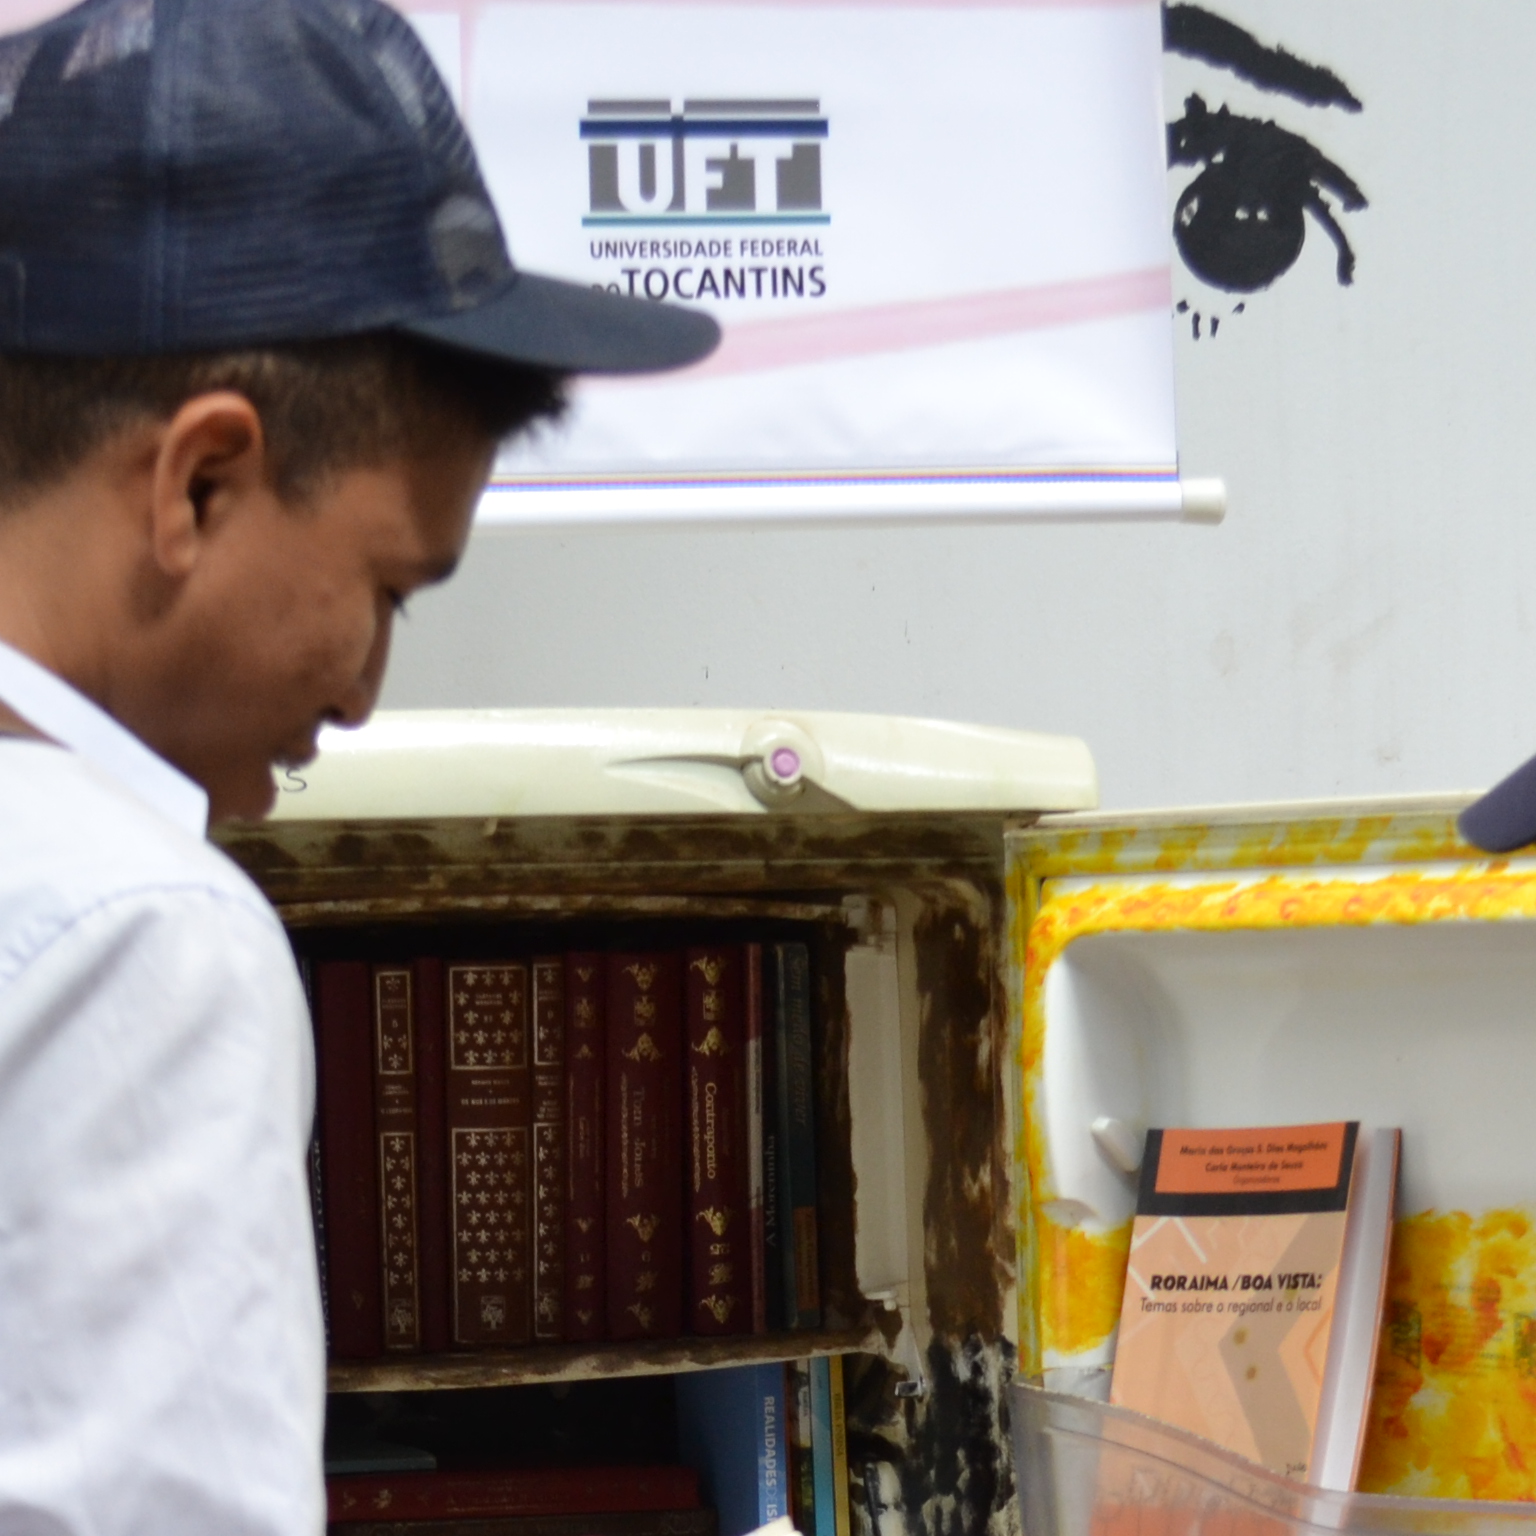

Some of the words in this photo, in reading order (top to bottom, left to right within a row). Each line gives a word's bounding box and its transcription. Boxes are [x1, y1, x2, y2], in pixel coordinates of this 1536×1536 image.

[590, 240, 732, 259] UNIVERSIDADE
[740, 238, 824, 257] FEDERAL
[621, 264, 827, 301] TOCANTINS
[632, 1087, 646, 1127] Tom
[703, 1081, 718, 1181] Contraponto
[765, 1134, 777, 1227] Moreninha
[1150, 1275, 1229, 1291] RORAIMA
[1277, 1273, 1323, 1289] VISTA:
[1140, 1297, 1177, 1313] Temas
[1180, 1297, 1213, 1313] sobre
[1216, 1301, 1224, 1313] o
[1227, 1297, 1274, 1317] regional
[1276, 1300, 1283, 1311] e
[1285, 1300, 1294, 1311] o
[1296, 1296, 1322, 1311] local
[764, 1396, 777, 1487] REALIDADES
